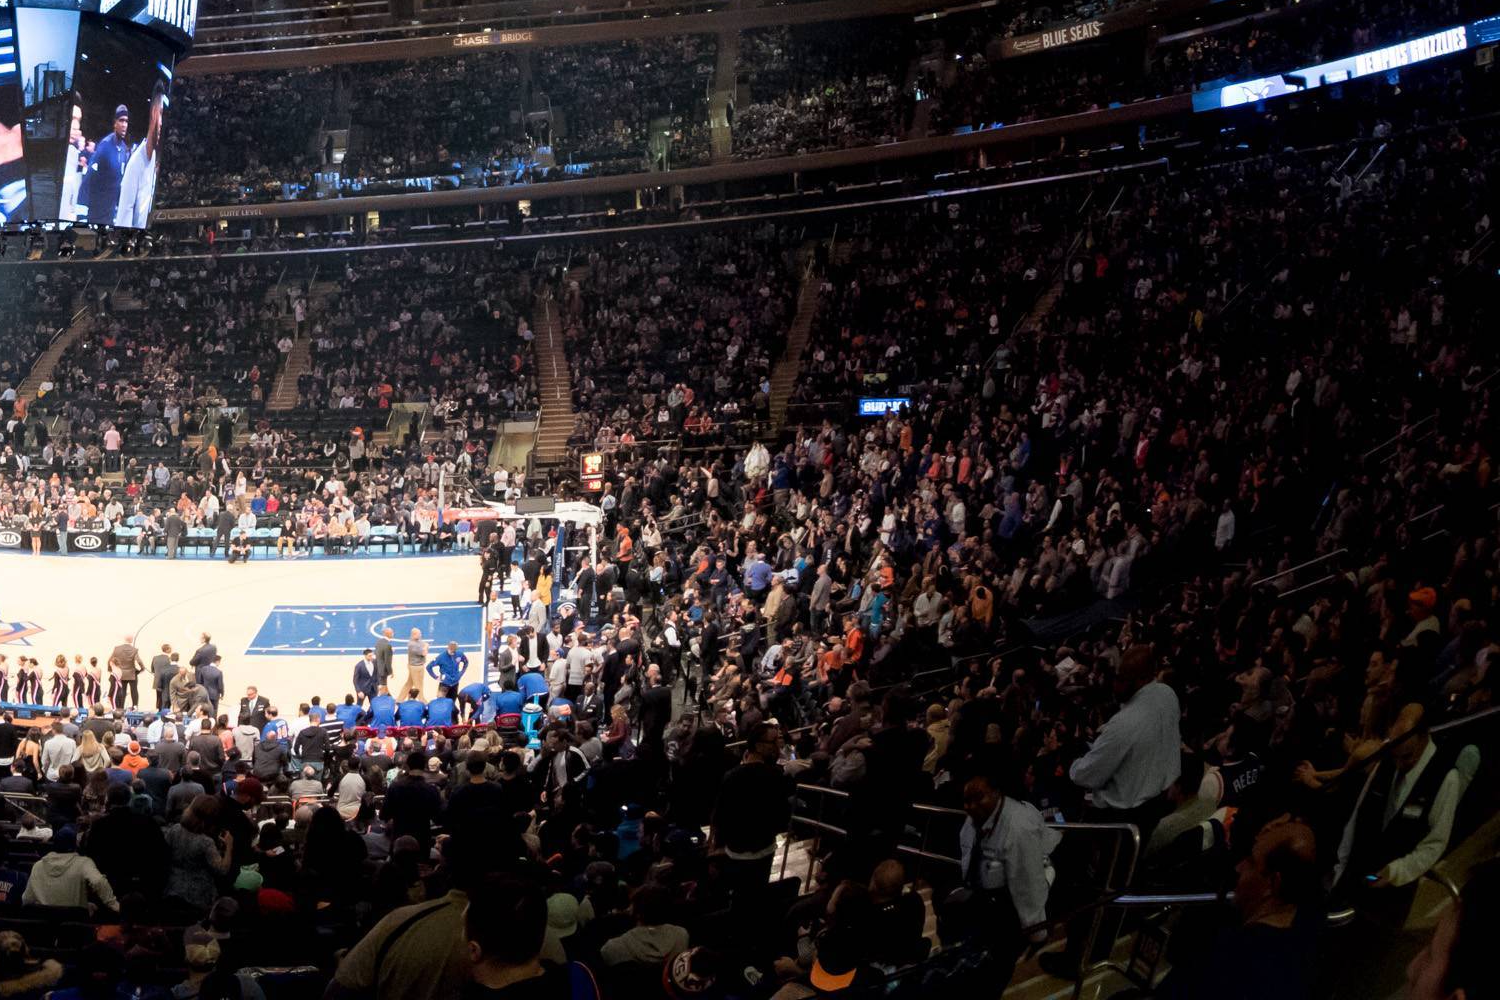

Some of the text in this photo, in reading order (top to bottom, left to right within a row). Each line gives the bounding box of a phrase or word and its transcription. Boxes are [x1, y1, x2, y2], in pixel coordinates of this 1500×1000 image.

[453, 31, 533, 46] CHASE BRIDGE
[1042, 28, 1068, 49] BLUE
[1070, 20, 1104, 42] SEATS
[1356, 26, 1467, 77] MEMPHIS GRIZZLIES
[241, 209, 264, 217] LEVEL
[863, 401, 887, 412] BUD
[0, 534, 17, 543] KIA
[78, 537, 97, 546] KIA
[1232, 768, 1259, 793] REED
